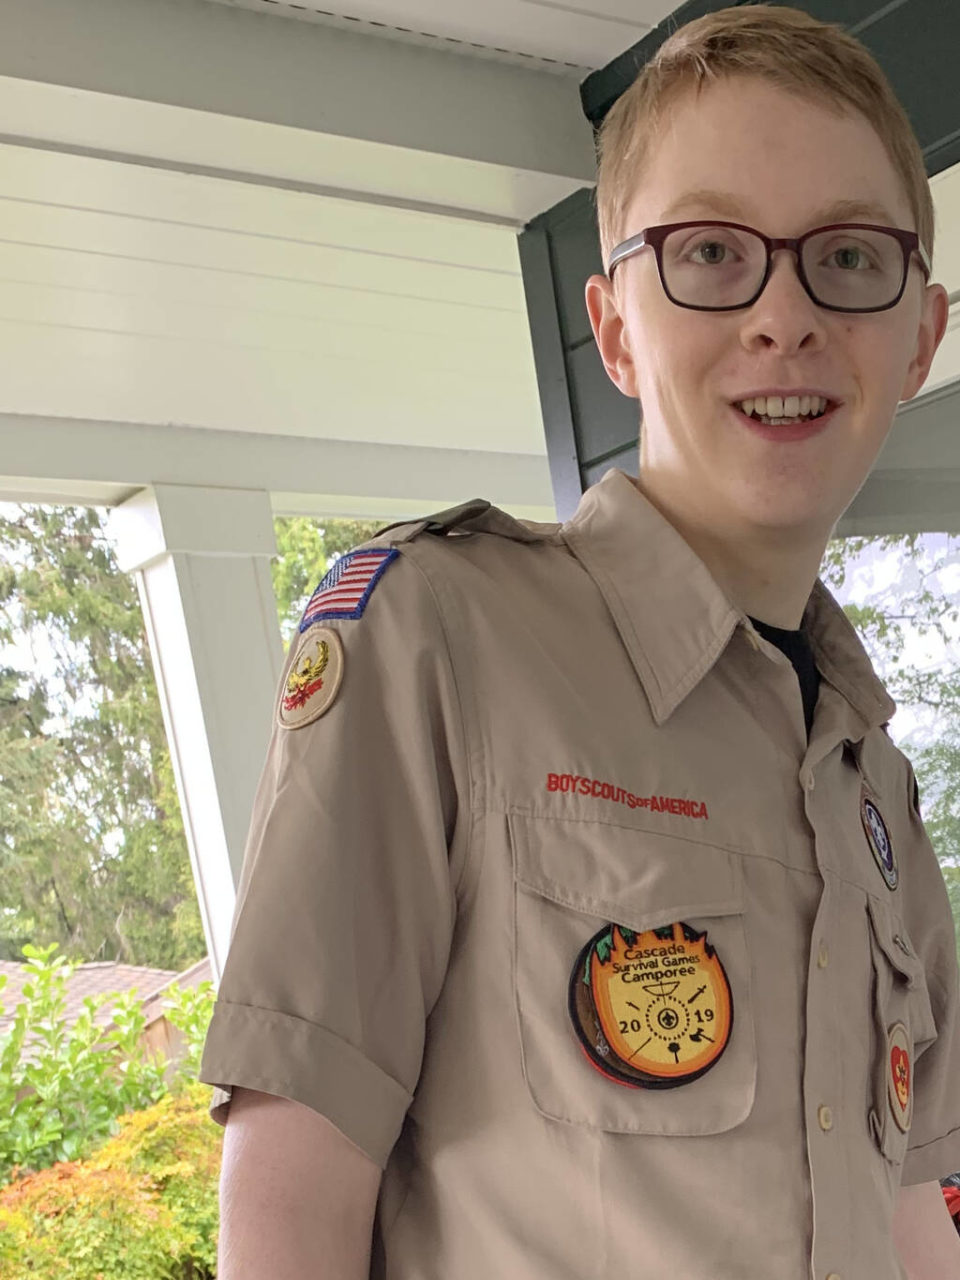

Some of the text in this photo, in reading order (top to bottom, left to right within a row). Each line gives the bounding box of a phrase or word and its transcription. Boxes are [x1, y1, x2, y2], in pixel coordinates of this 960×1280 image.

[546, 773, 580, 793] BOY
[578, 777, 637, 809] SCOUTS
[650, 796, 709, 820] AMERICA
[624, 943, 685, 961] Cascade
[612, 954, 701, 974] Survival Games
[621, 966, 696, 983] Camporee
[619, 1008, 714, 1034] 20 19
